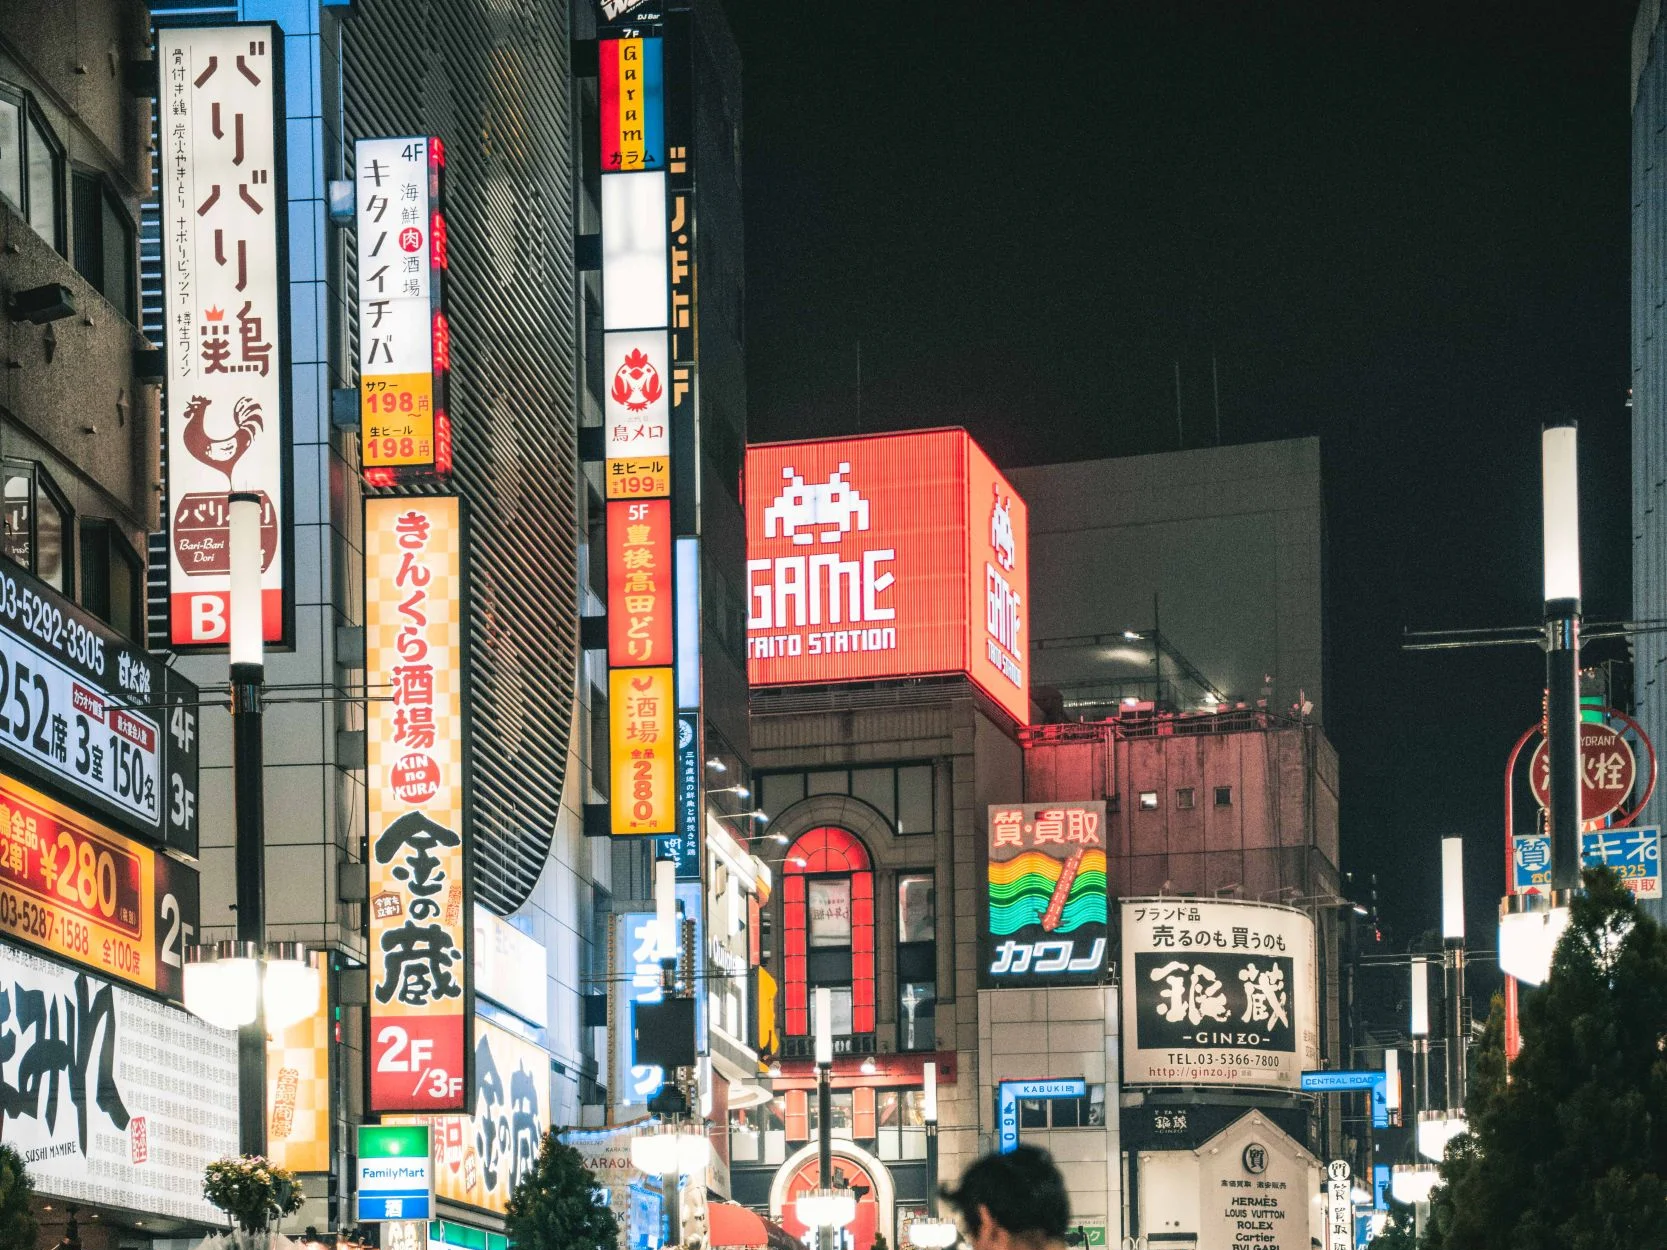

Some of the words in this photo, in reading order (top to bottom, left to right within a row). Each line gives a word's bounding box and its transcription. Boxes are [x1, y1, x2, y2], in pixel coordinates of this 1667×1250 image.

[623, 29, 639, 38] 7F
[623, 46, 642, 141] Garam
[402, 143, 423, 161] 4F
[610, 151, 655, 164] ガラム
[363, 159, 393, 364] キタノイチバ
[366, 381, 398, 391] サワー
[370, 425, 413, 437] 生ビール
[612, 461, 664, 475] 生ビール
[628, 505, 648, 520] 5F
[180, 538, 224, 550] Bari-Bari
[193, 552, 214, 562] Dori
[623, 524, 657, 661] 豊後高田どり
[748, 549, 895, 629] GAME
[393, 511, 436, 749] きんくら酒場
[808, 628, 896, 655] STATION
[171, 699, 194, 753] 4F
[626, 697, 659, 743] 酒場
[1580, 736, 1616, 746] YDRANT
[75, 714, 103, 783] 3室
[109, 735, 155, 812] 150名
[397, 756, 429, 770] KIN
[405, 771, 426, 781] no
[394, 782, 438, 799] KURA
[633, 761, 653, 820] 280
[171, 772, 194, 831] 3F
[40, 831, 117, 917] ¥280
[375, 811, 461, 1005] 金の蔵
[1134, 908, 1200, 921] ブランド品
[0, 891, 89, 955] 03-5287-1588
[102, 938, 140, 976] 全100席
[377, 1025, 433, 1072] 2F
[1168, 1053, 1280, 1067] TEL.03-5366-7800
[1149, 1067, 1238, 1078] http://ginzo.jp
[1306, 1077, 1347, 1085] CENTRAL
[25, 1147, 48, 1163] SUSHI
[49, 1141, 77, 1158] MAMIRE
[362, 1167, 424, 1179] FamilyMart
[1225, 1209, 1247, 1218] LOUIS
[1252, 1210, 1285, 1219] VUITTON
[1237, 1221, 1273, 1230] ROLEX
[1236, 1233, 1275, 1242] Cartier
